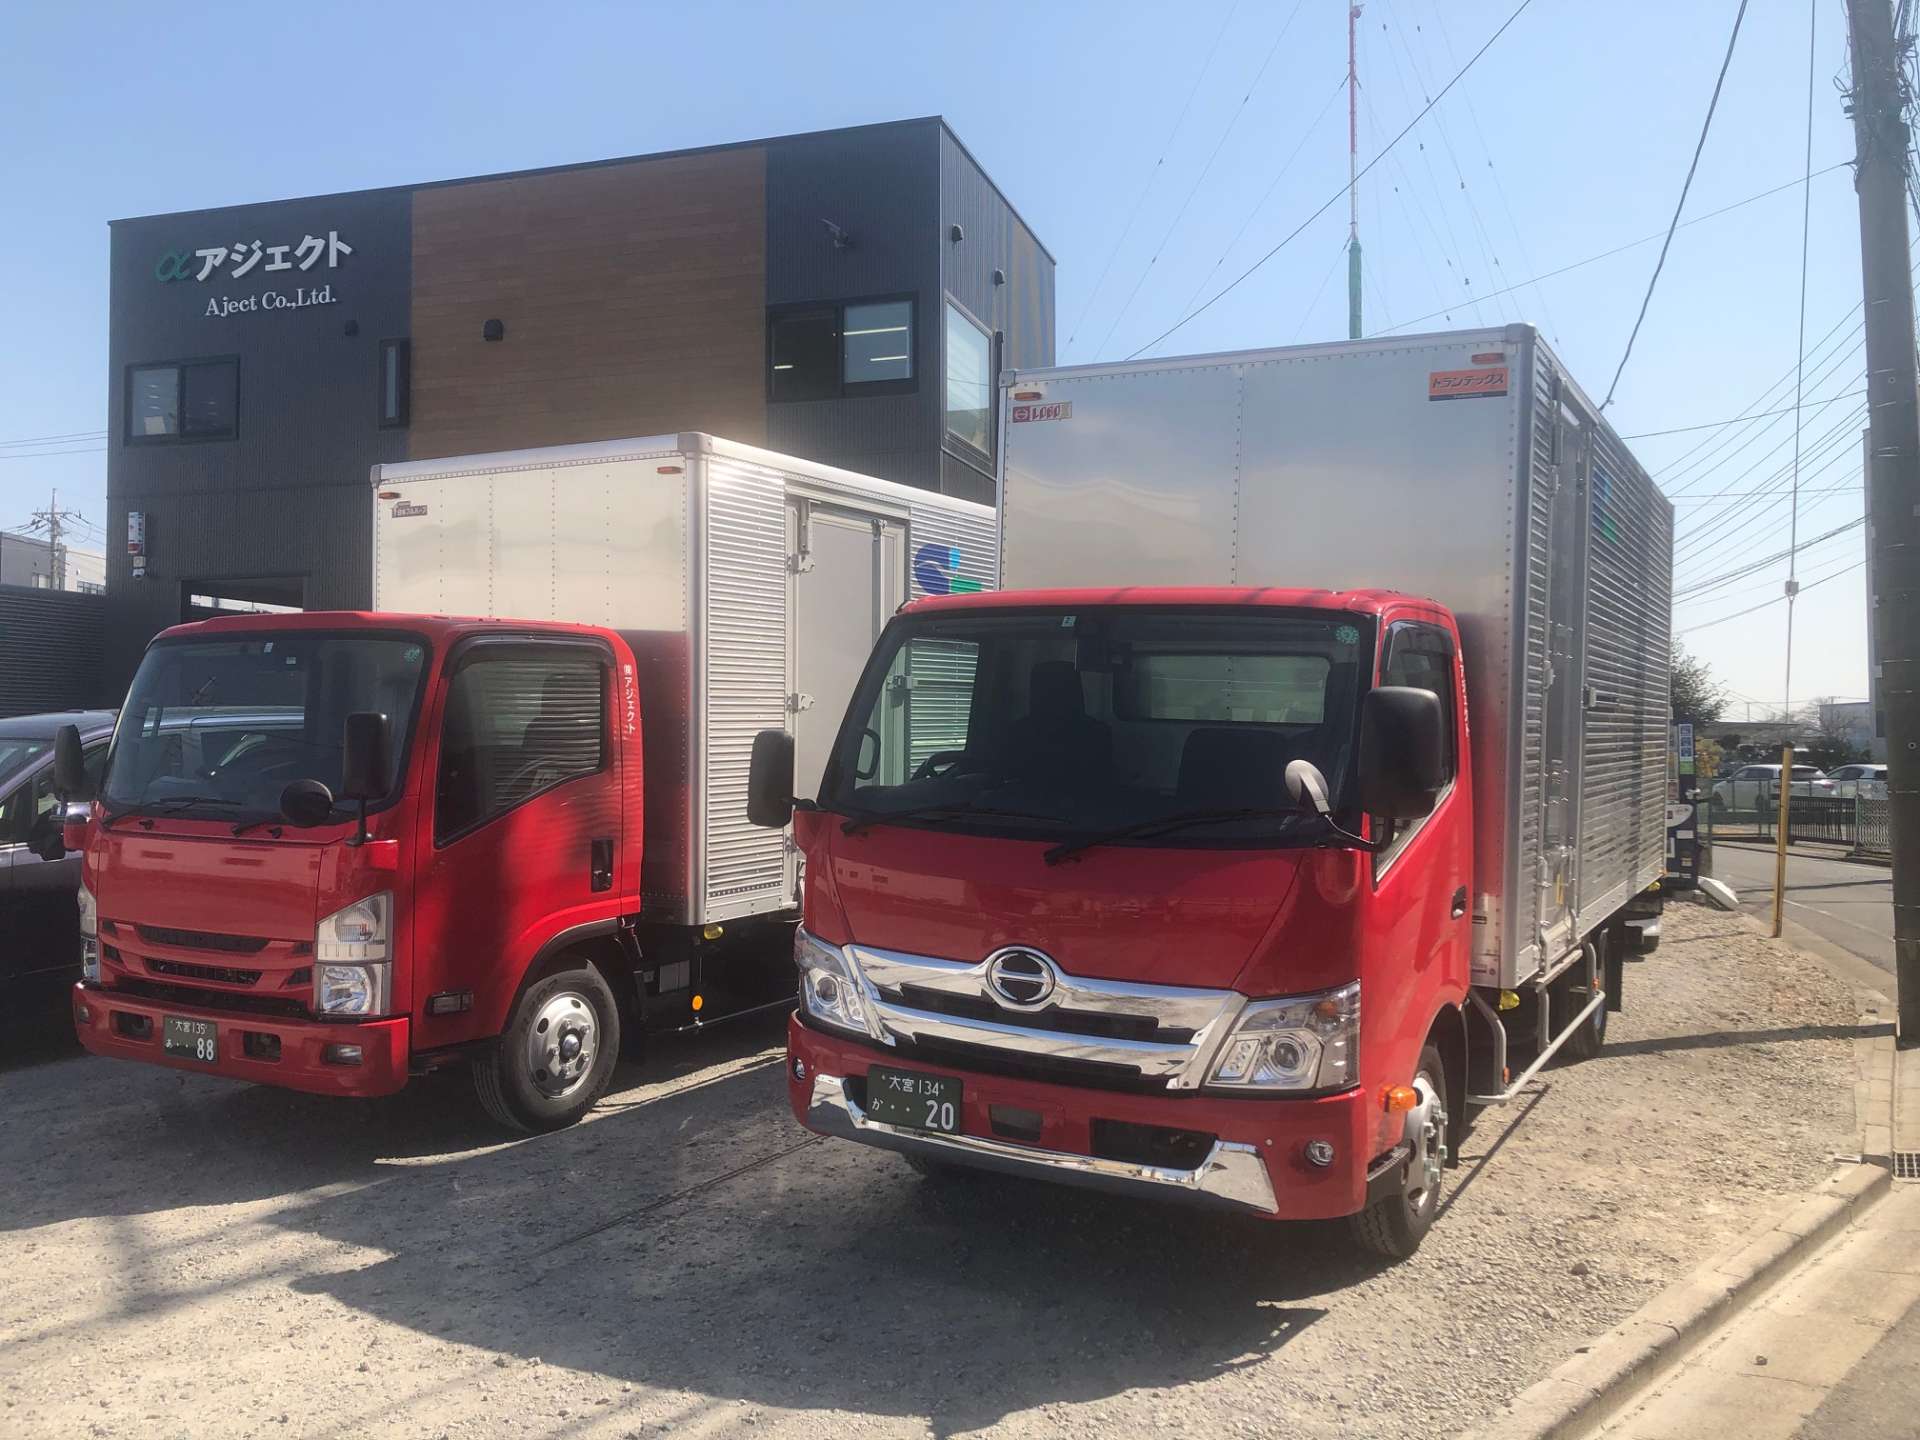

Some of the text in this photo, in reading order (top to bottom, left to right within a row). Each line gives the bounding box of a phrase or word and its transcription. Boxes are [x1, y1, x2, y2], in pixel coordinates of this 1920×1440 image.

[195, 231, 352, 282] アジェクト
[206, 296, 258, 317] Aject
[192, 1022, 206, 1035] 135
[196, 1037, 214, 1061] 88
[889, 1075, 939, 1097] 大宮 134
